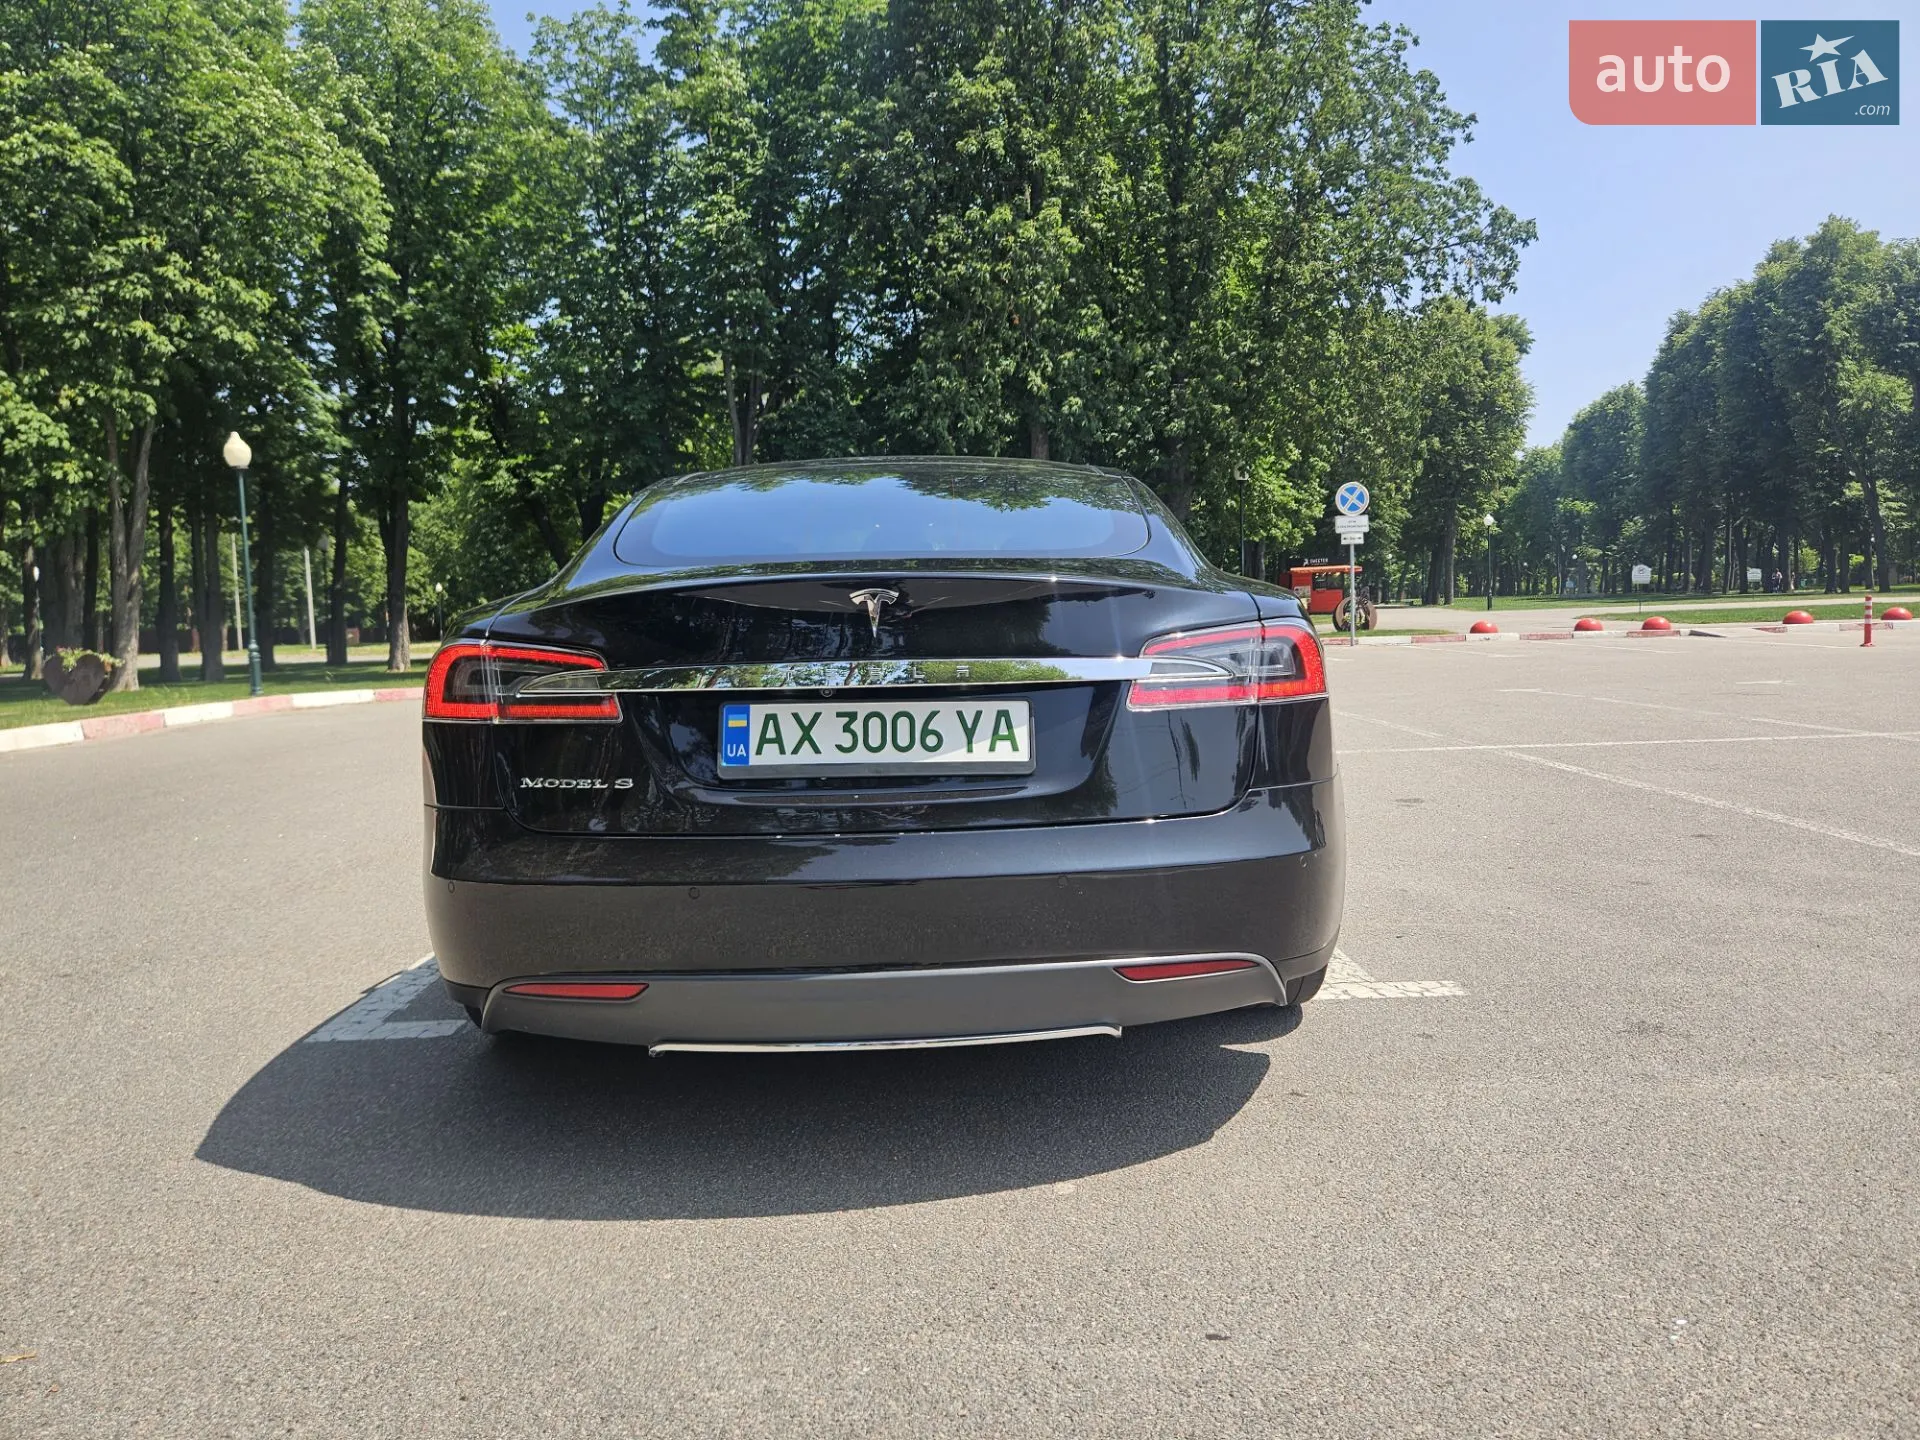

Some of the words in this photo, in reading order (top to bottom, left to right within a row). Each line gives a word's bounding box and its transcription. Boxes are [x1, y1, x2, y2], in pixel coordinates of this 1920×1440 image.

[755, 711, 823, 755] AX
[835, 710, 944, 754] 3006
[955, 709, 1020, 754] YA
[727, 743, 747, 757] UA
[520, 777, 609, 789] MODEL
[614, 778, 635, 789] S
